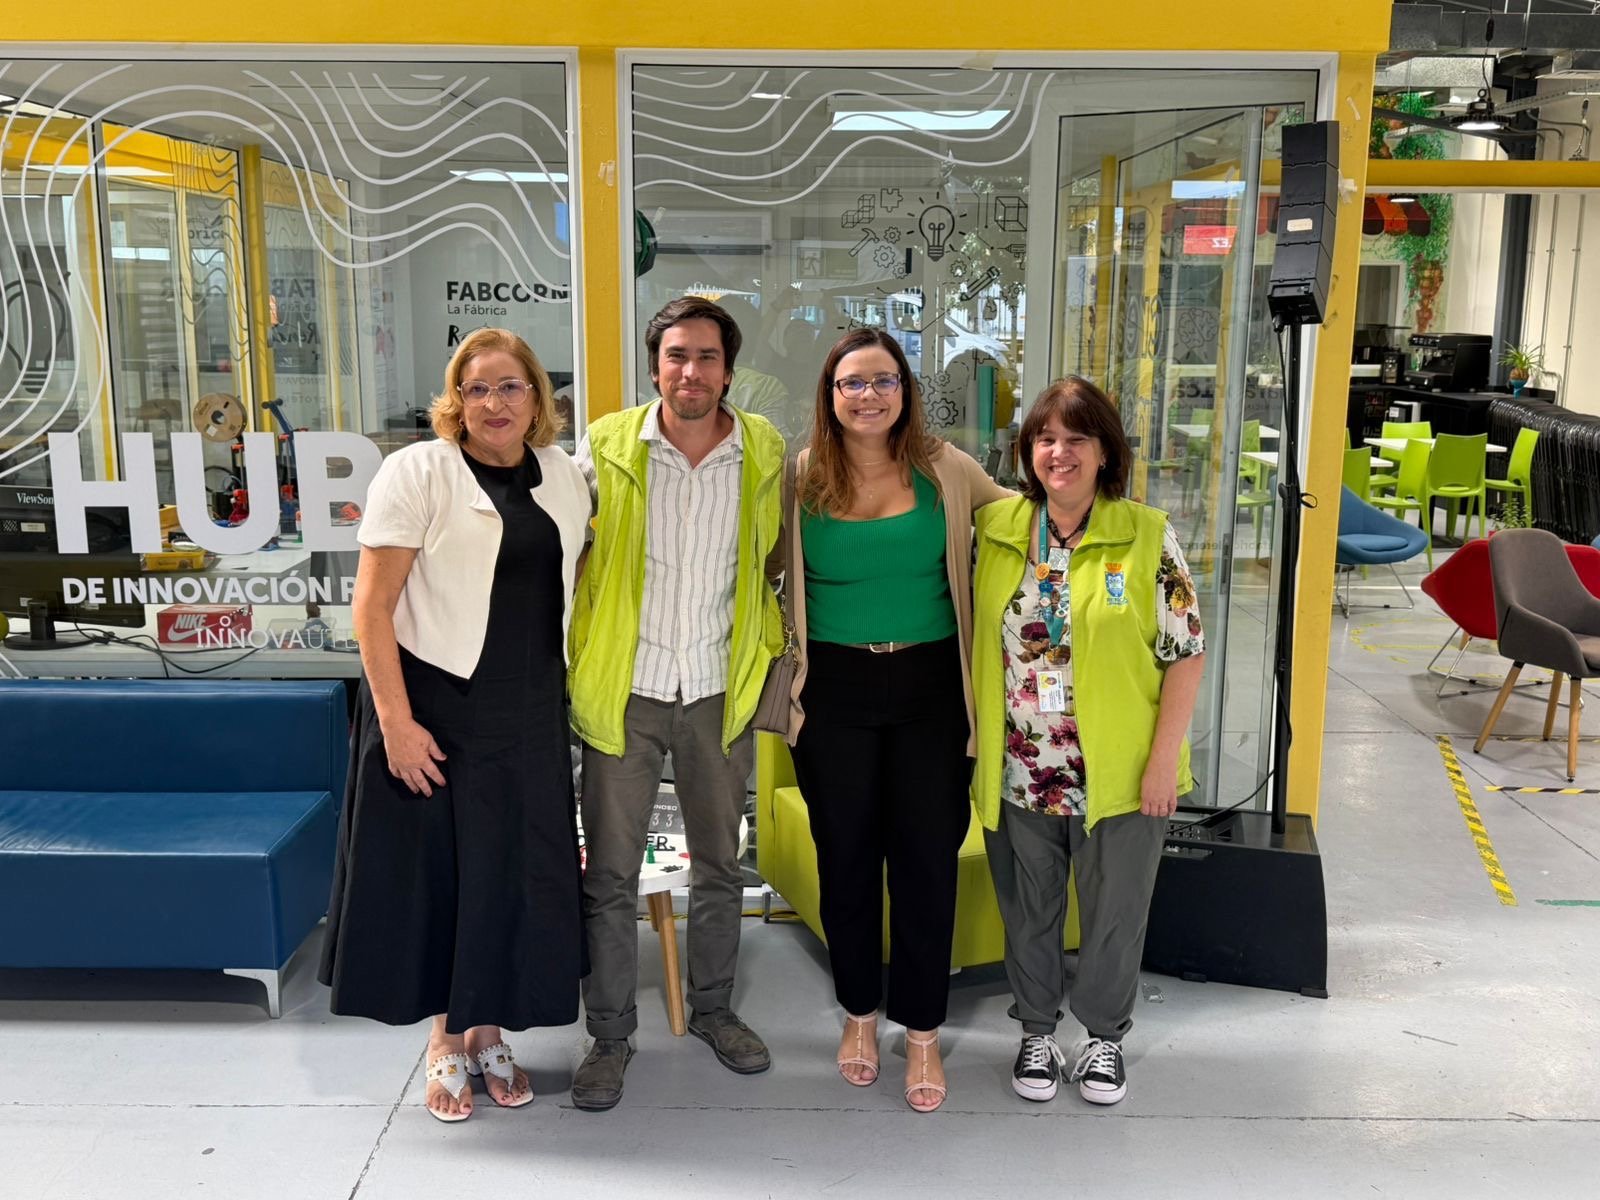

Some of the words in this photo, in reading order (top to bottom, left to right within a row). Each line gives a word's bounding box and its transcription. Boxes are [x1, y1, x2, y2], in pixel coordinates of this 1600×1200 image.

[447, 304, 460, 315] La
[464, 304, 507, 316] Fábrica
[48, 431, 383, 554] HUB
[62, 577, 105, 605] DE
[114, 570, 332, 604] INNOVACIÓN
[175, 613, 207, 630] NIKE
